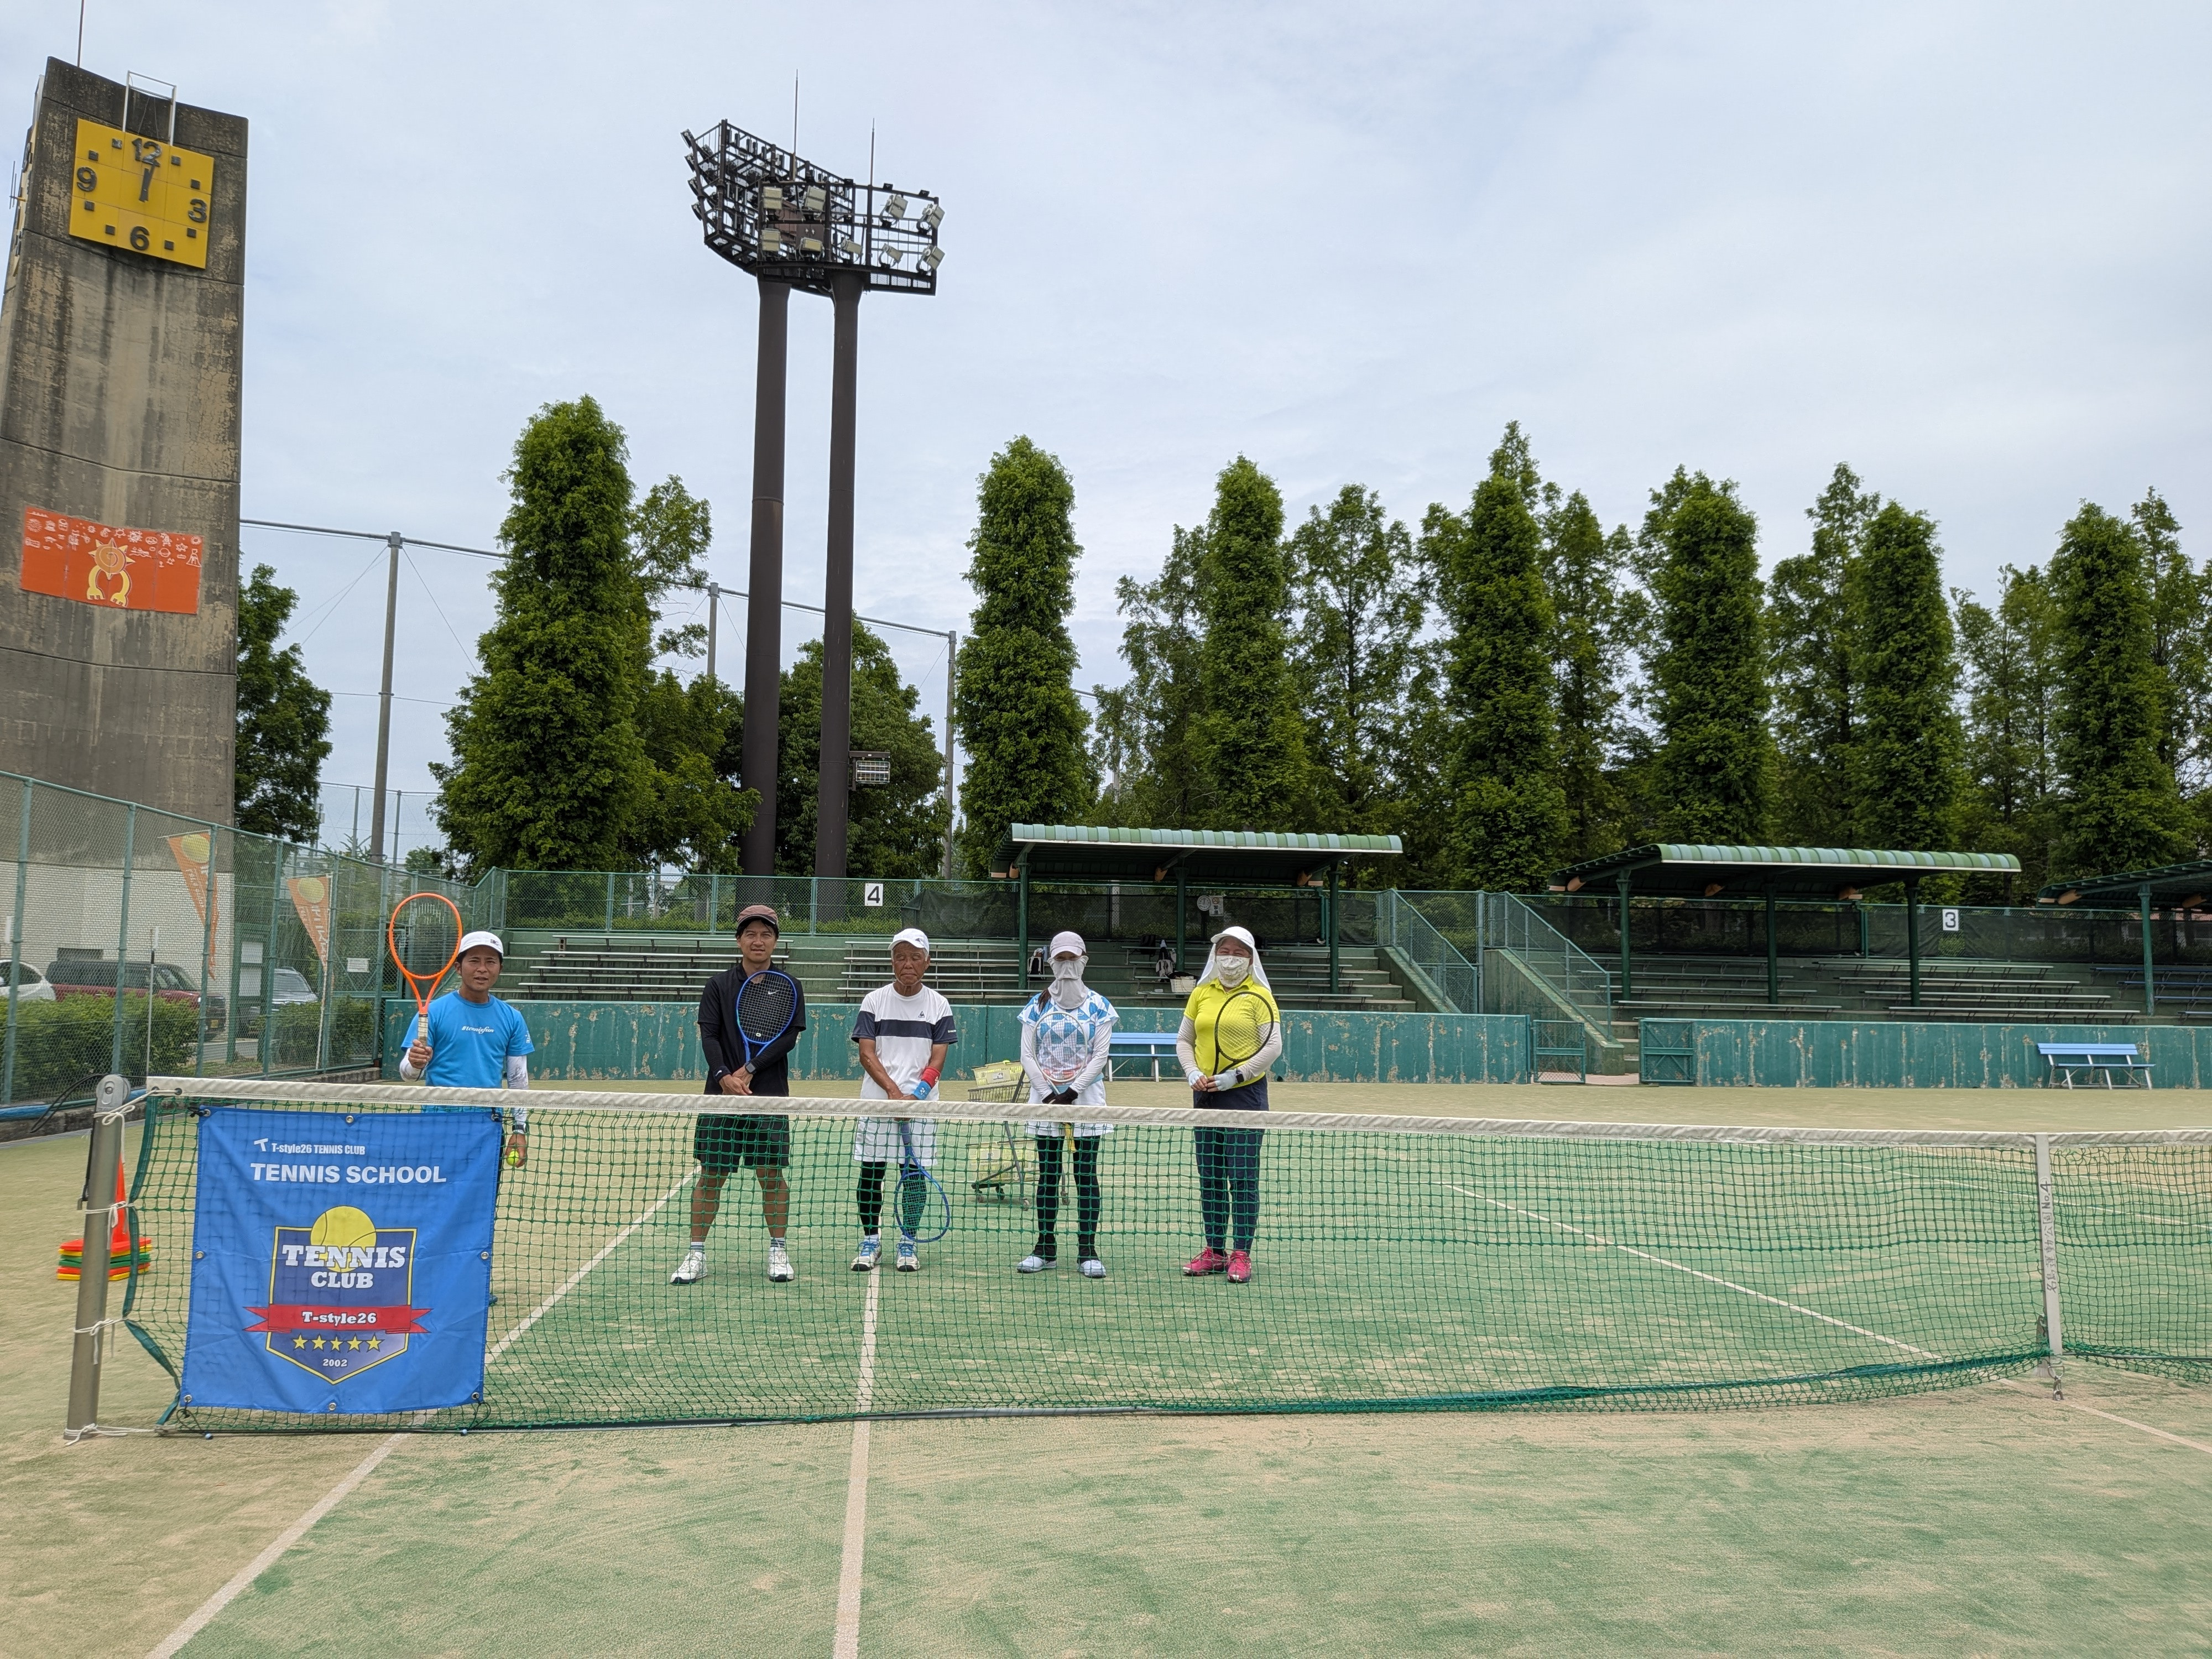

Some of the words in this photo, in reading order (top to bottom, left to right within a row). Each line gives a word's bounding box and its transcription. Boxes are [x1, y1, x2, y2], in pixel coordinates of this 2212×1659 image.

[132, 138, 160, 167] 12
[77, 166, 97, 192] 9
[187, 199, 207, 223] 3
[130, 226, 149, 251] 6
[867, 886, 880, 904] 4
[1945, 912, 1956, 928] 3
[272, 1143, 312, 1154] T-style26
[314, 1145, 343, 1154] TENNIS
[345, 1145, 366, 1155] CLUB
[251, 1163, 340, 1183] TENNIS
[346, 1166, 447, 1184] SCHOOL
[282, 1244, 406, 1269] TENNIS
[311, 1271, 374, 1288] CLUB
[302, 1311, 377, 1327] T-style26
[322, 1358, 348, 1367] 2002
